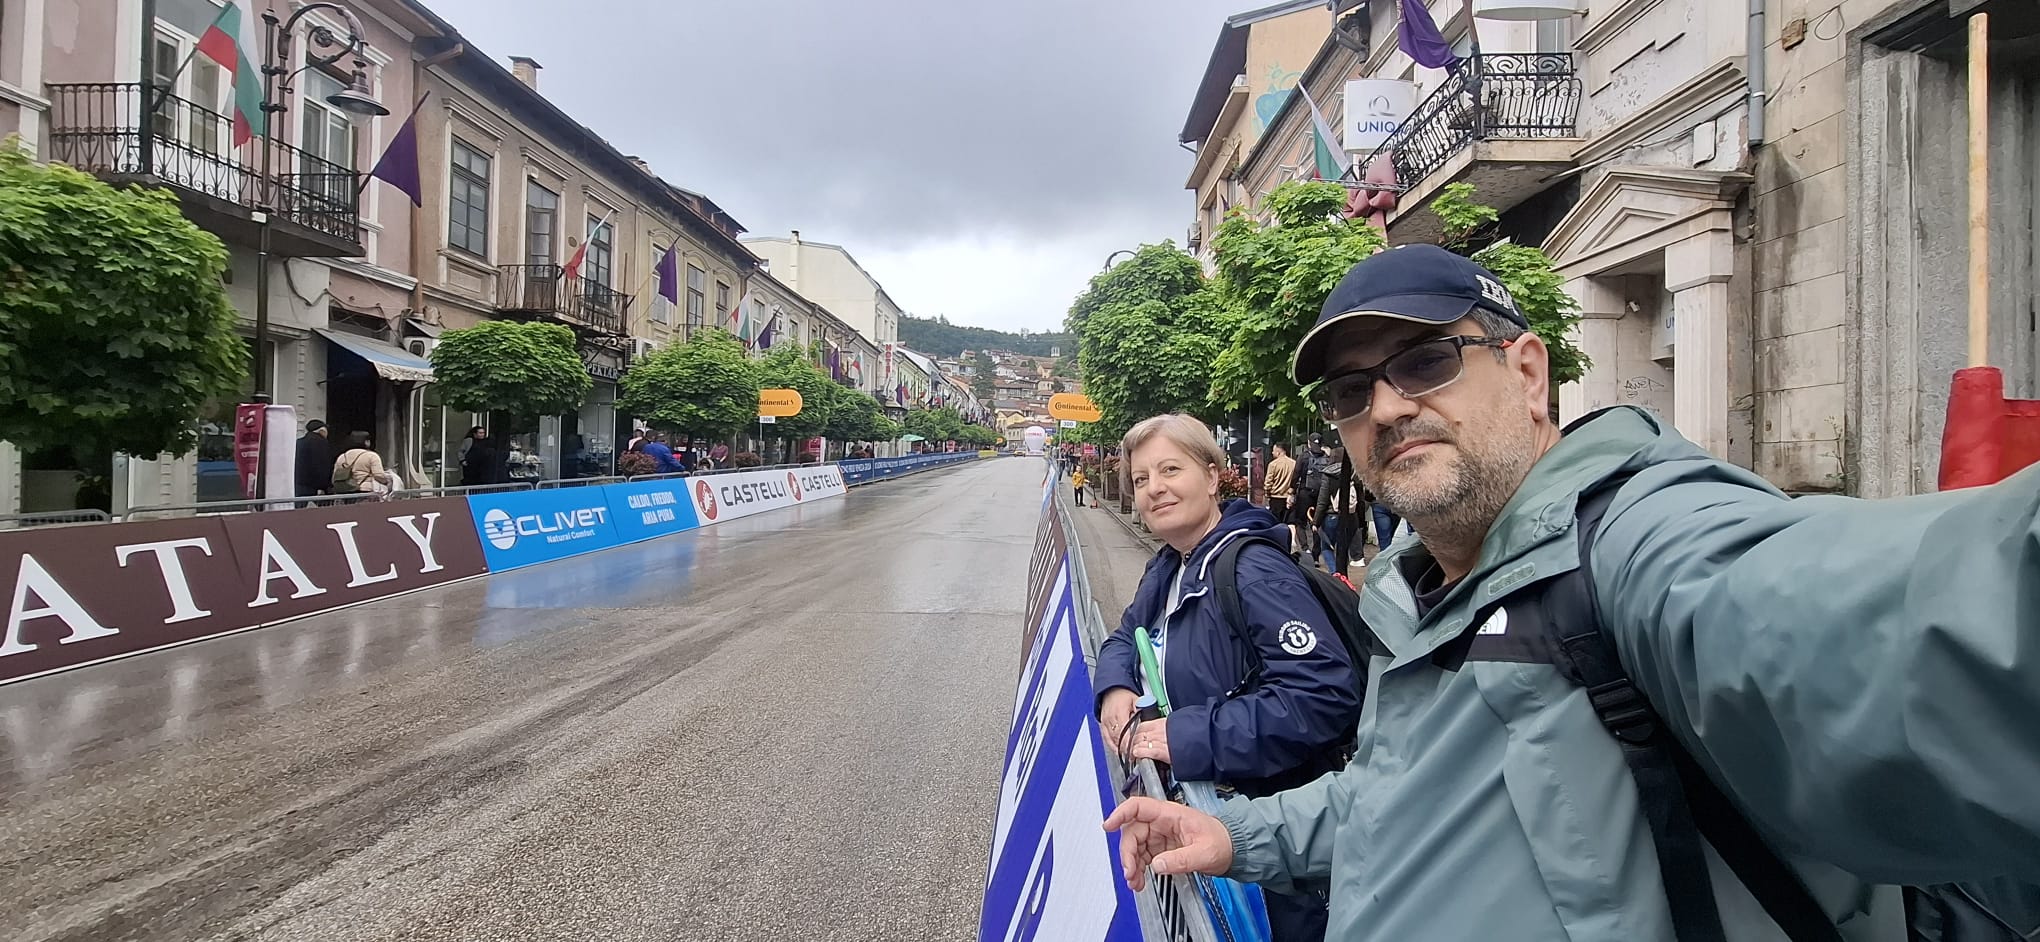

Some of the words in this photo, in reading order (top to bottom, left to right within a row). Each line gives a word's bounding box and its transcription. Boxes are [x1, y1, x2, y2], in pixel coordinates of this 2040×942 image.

[1475, 274, 1519, 316] IBM
[1054, 402, 1092, 411] Continental
[801, 473, 842, 491] CASTELLI
[721, 481, 787, 506] CASTELLI
[642, 510, 658, 525] ARIA
[657, 508, 675, 522] PURA
[546, 532, 571, 544] Natural
[570, 529, 596, 539] Comfort
[0, 512, 444, 656] ATALY
